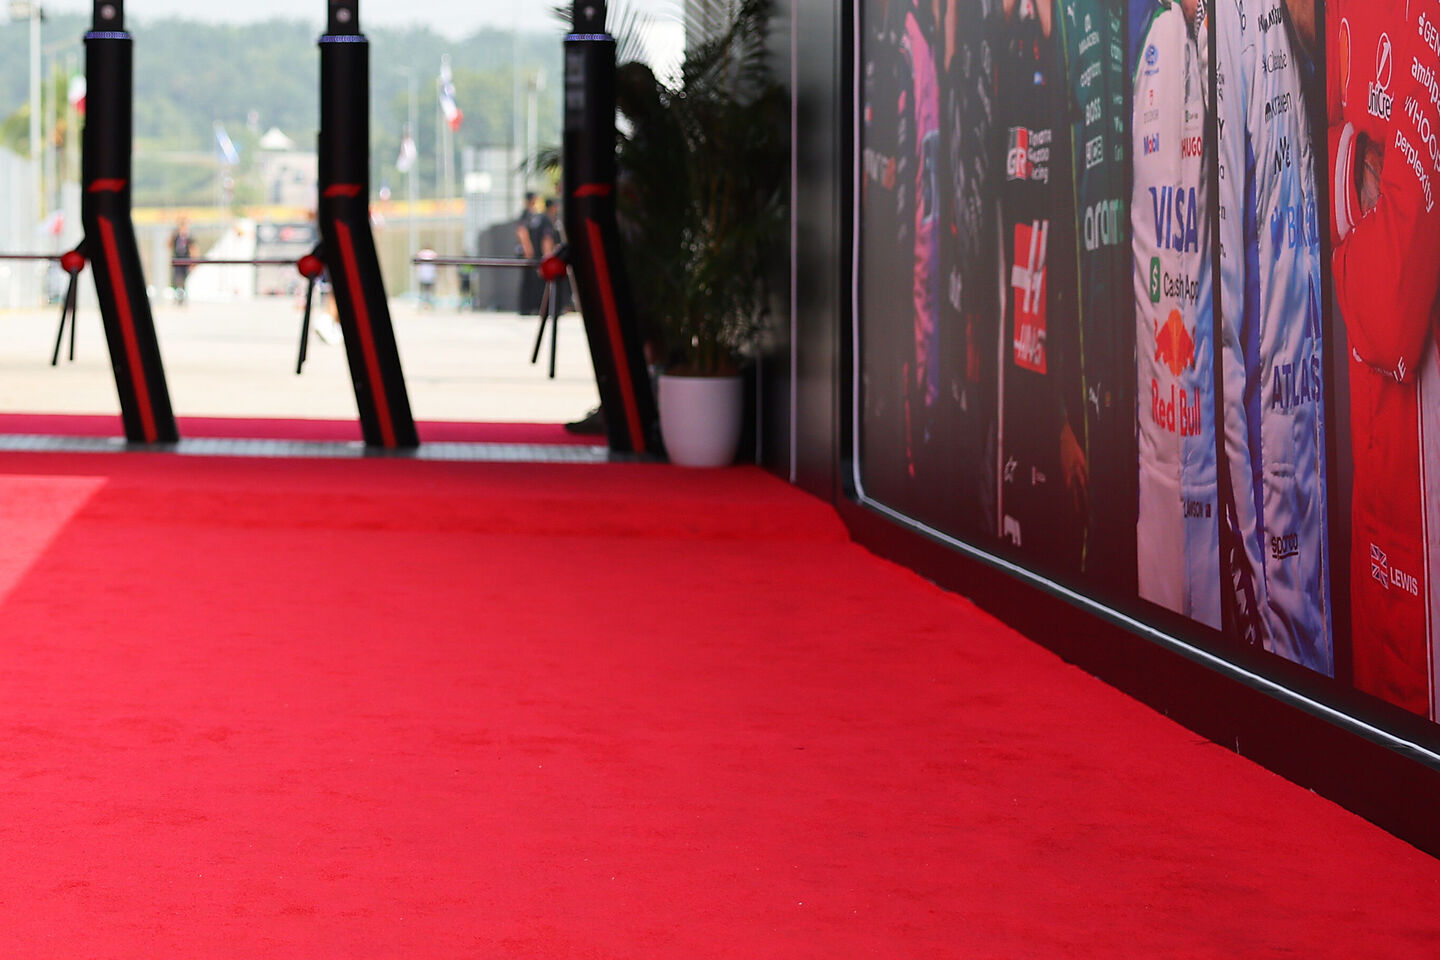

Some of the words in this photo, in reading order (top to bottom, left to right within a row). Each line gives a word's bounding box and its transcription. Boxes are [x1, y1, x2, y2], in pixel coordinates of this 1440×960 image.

[1267, 50, 1288, 74] Claude
[1143, 132, 1160, 156] Mobil
[1181, 136, 1203, 160] HUGO
[1395, 130, 1434, 213] perplexity
[1148, 186, 1199, 253] VISA
[1163, 271, 1184, 298] Cash
[1184, 274, 1200, 306] App
[1271, 354, 1321, 410] ATLAS
[1151, 377, 1176, 433] Red
[1179, 386, 1202, 437] Bull
[1390, 566, 1418, 597] LEWIS
